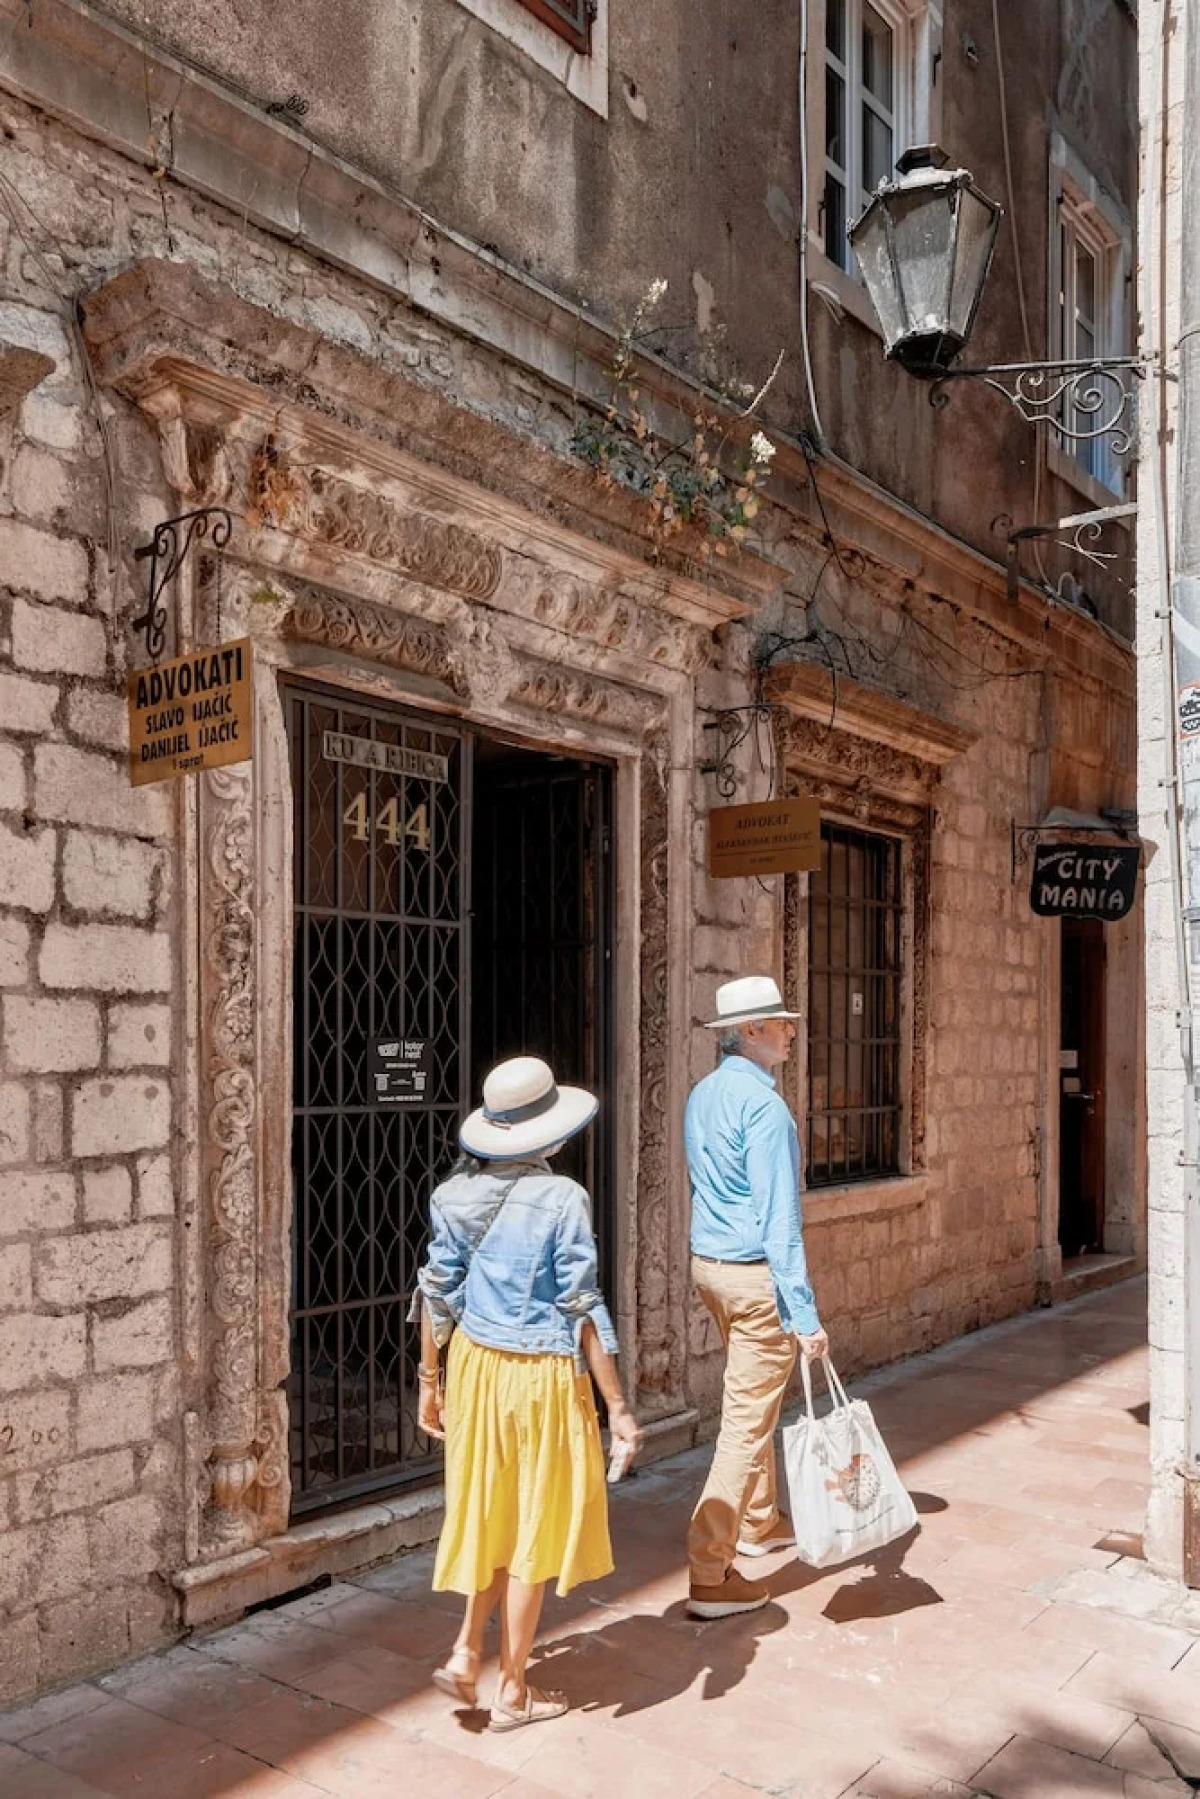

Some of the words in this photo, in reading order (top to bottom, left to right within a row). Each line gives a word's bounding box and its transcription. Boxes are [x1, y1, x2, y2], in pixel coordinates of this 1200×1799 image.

[136, 647, 242, 709] ADVOKATI
[146, 707, 184, 734] SLAVO
[141, 733, 189, 762] DANIJEL
[343, 791, 430, 850] 444
[735, 814, 790, 830] ADVOKAT
[1058, 857, 1121, 880] CITY
[1040, 884, 1125, 910] MANIA
